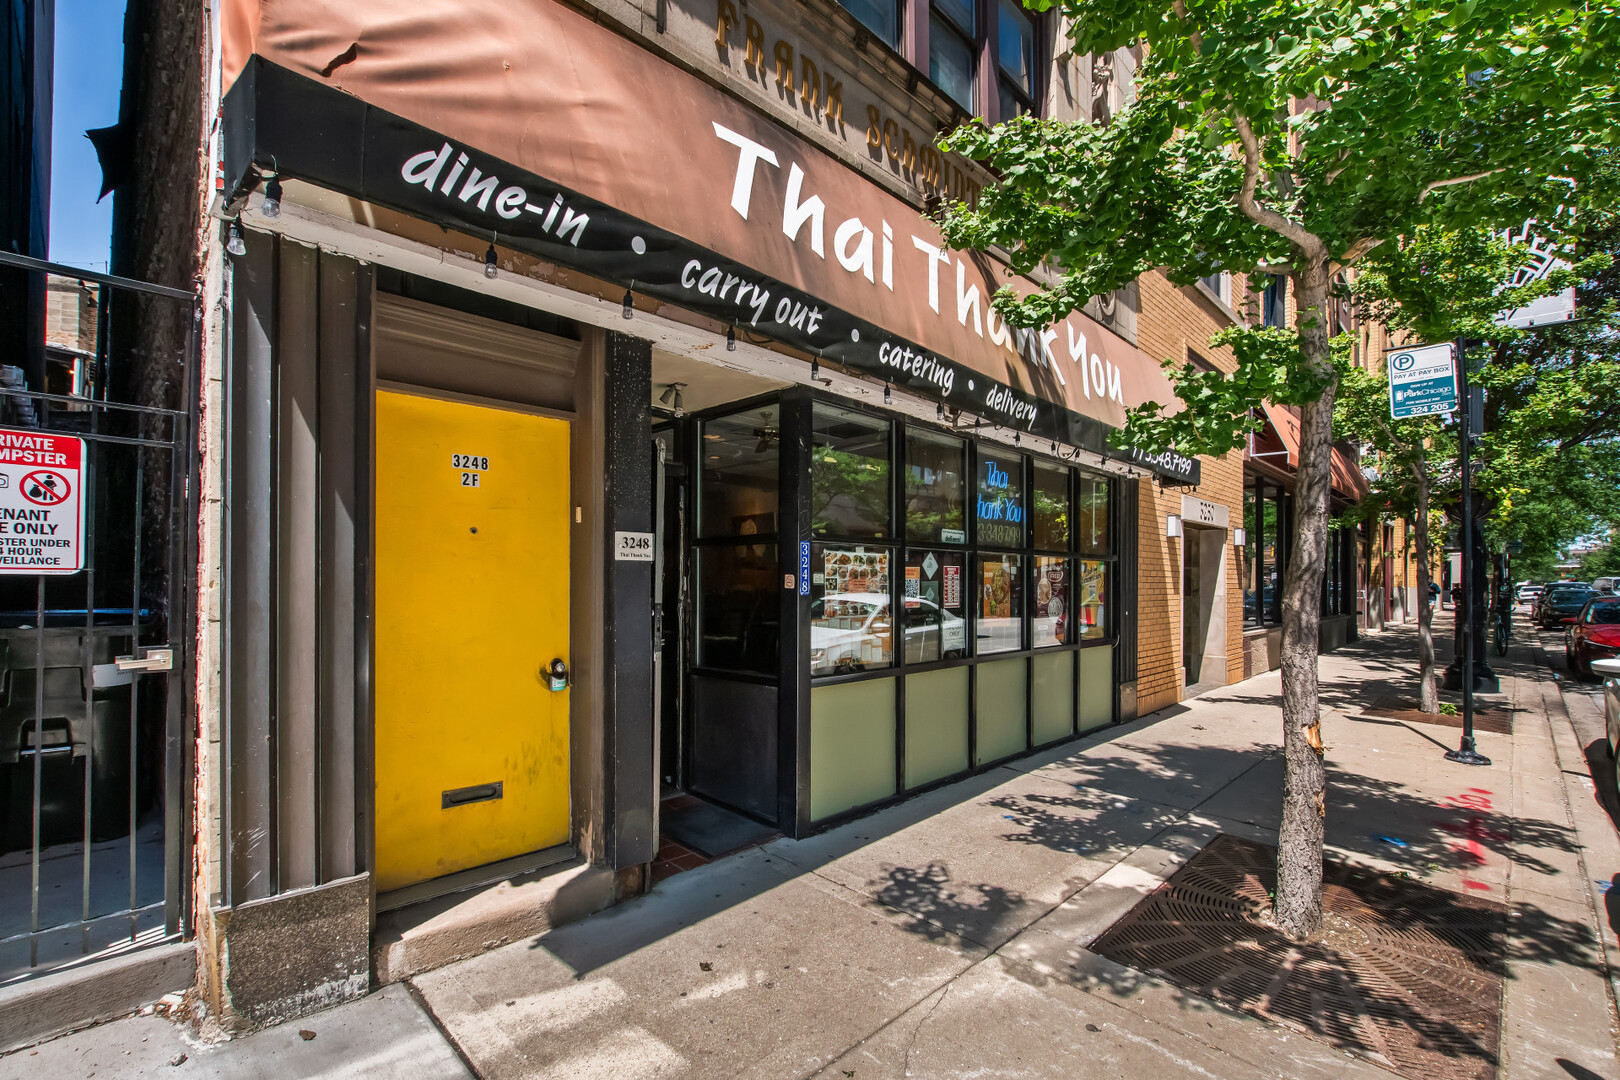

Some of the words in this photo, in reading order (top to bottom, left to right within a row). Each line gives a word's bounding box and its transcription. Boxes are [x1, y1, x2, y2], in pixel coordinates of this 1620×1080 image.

[401, 142, 590, 247] dine-in
[712, 121, 894, 292] Thai
[911, 235, 1066, 386] Thank
[1067, 320, 1124, 405] You
[681, 259, 770, 327] carry
[774, 297, 823, 335] out
[879, 342, 955, 396] catering
[1394, 372, 1407, 380] PAY
[1404, 386, 1452, 398] ParkChicago
[986, 384, 1038, 431] delivery
[1410, 405, 1428, 415] 324
[1431, 402, 1449, 412] 205
[453, 455, 488, 470] 3248
[462, 473, 478, 487] 2F
[985, 461, 1008, 489] Thai
[977, 493, 1003, 519] hank
[1005, 498, 1022, 523] You
[13, 522, 58, 535] ONLY
[30, 539, 70, 547] UNDER
[622, 536, 650, 550] 3248
[8, 547, 42, 556] HOUR
